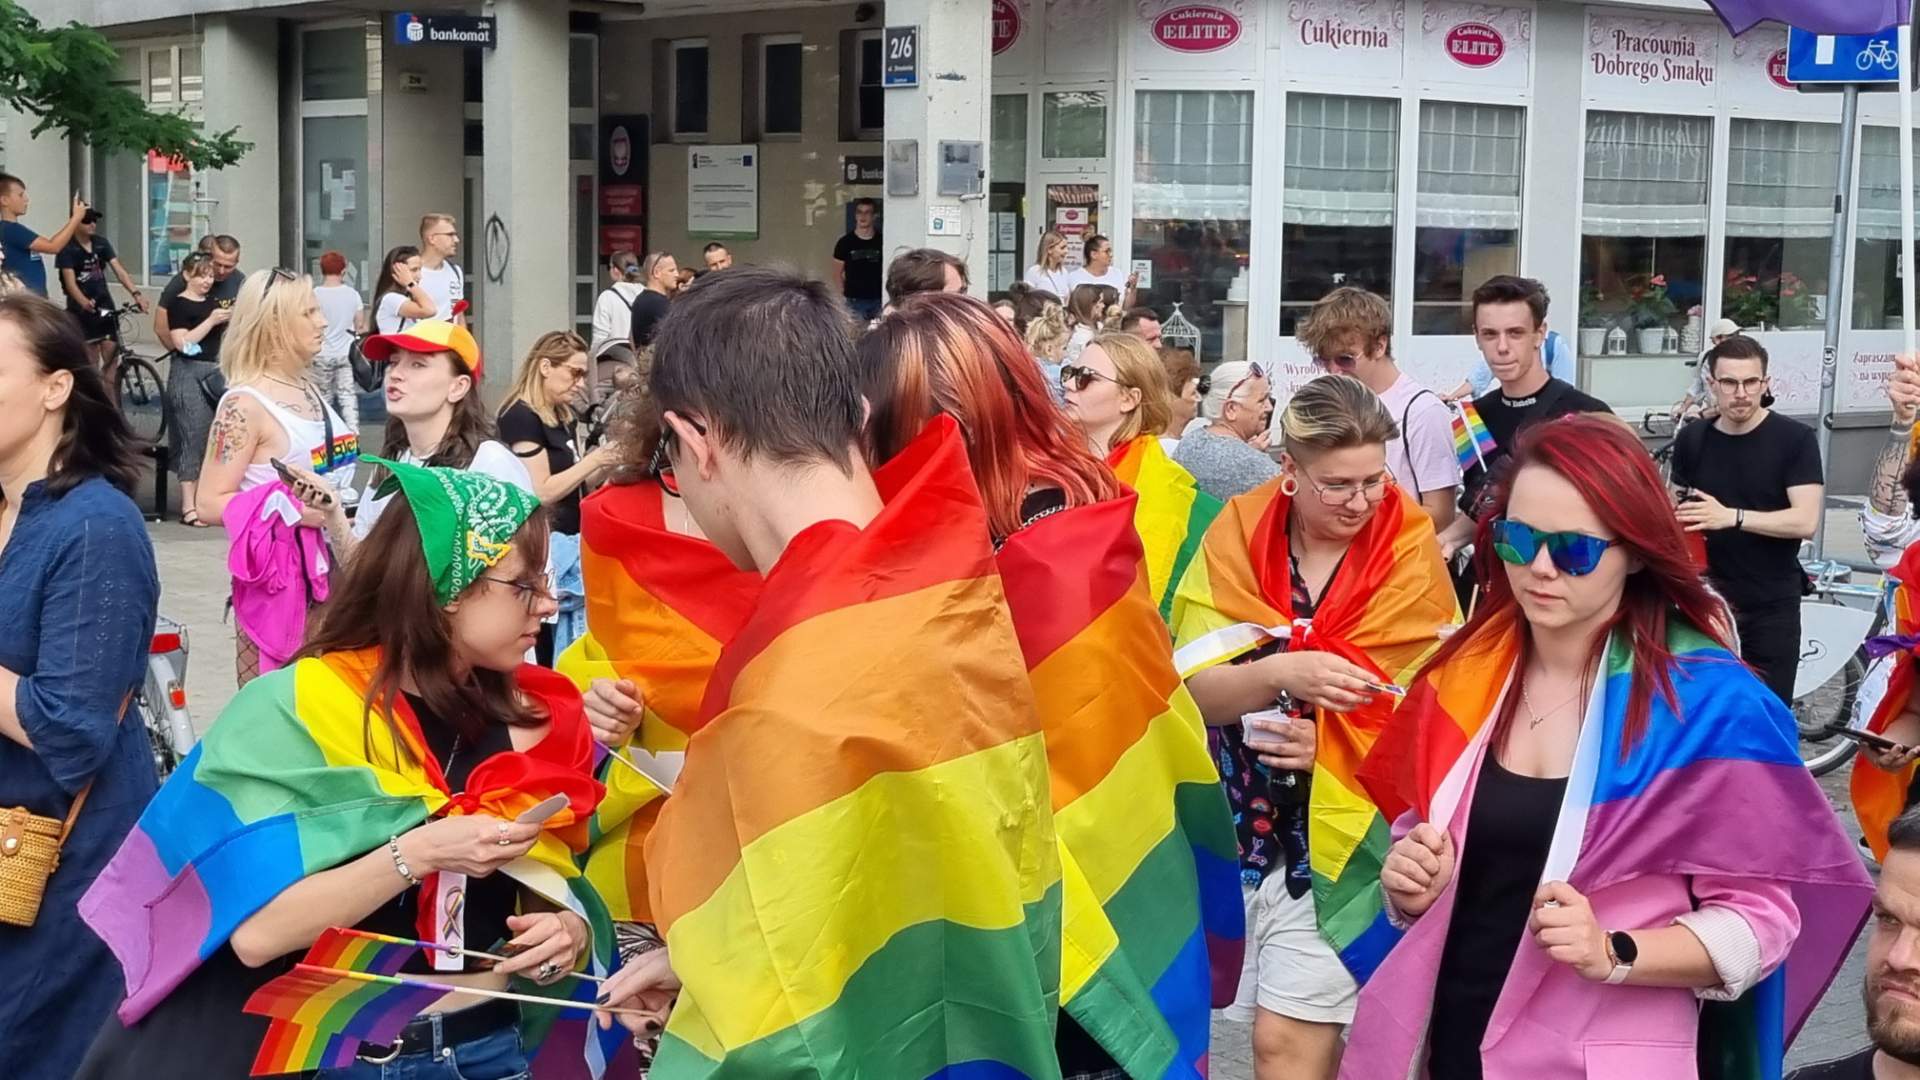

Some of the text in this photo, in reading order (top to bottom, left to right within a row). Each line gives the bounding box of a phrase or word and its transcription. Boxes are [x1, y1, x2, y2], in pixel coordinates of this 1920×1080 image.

[430, 27, 489, 42] bankomat
[1163, 24, 1231, 40] ELITE
[1301, 18, 1388, 49] Cukiernia
[1612, 29, 1695, 57] Pracownia
[890, 35, 912, 59] 2/6
[1452, 39, 1499, 56] ELITE
[1591, 52, 1713, 86] Dobrego Smaku
